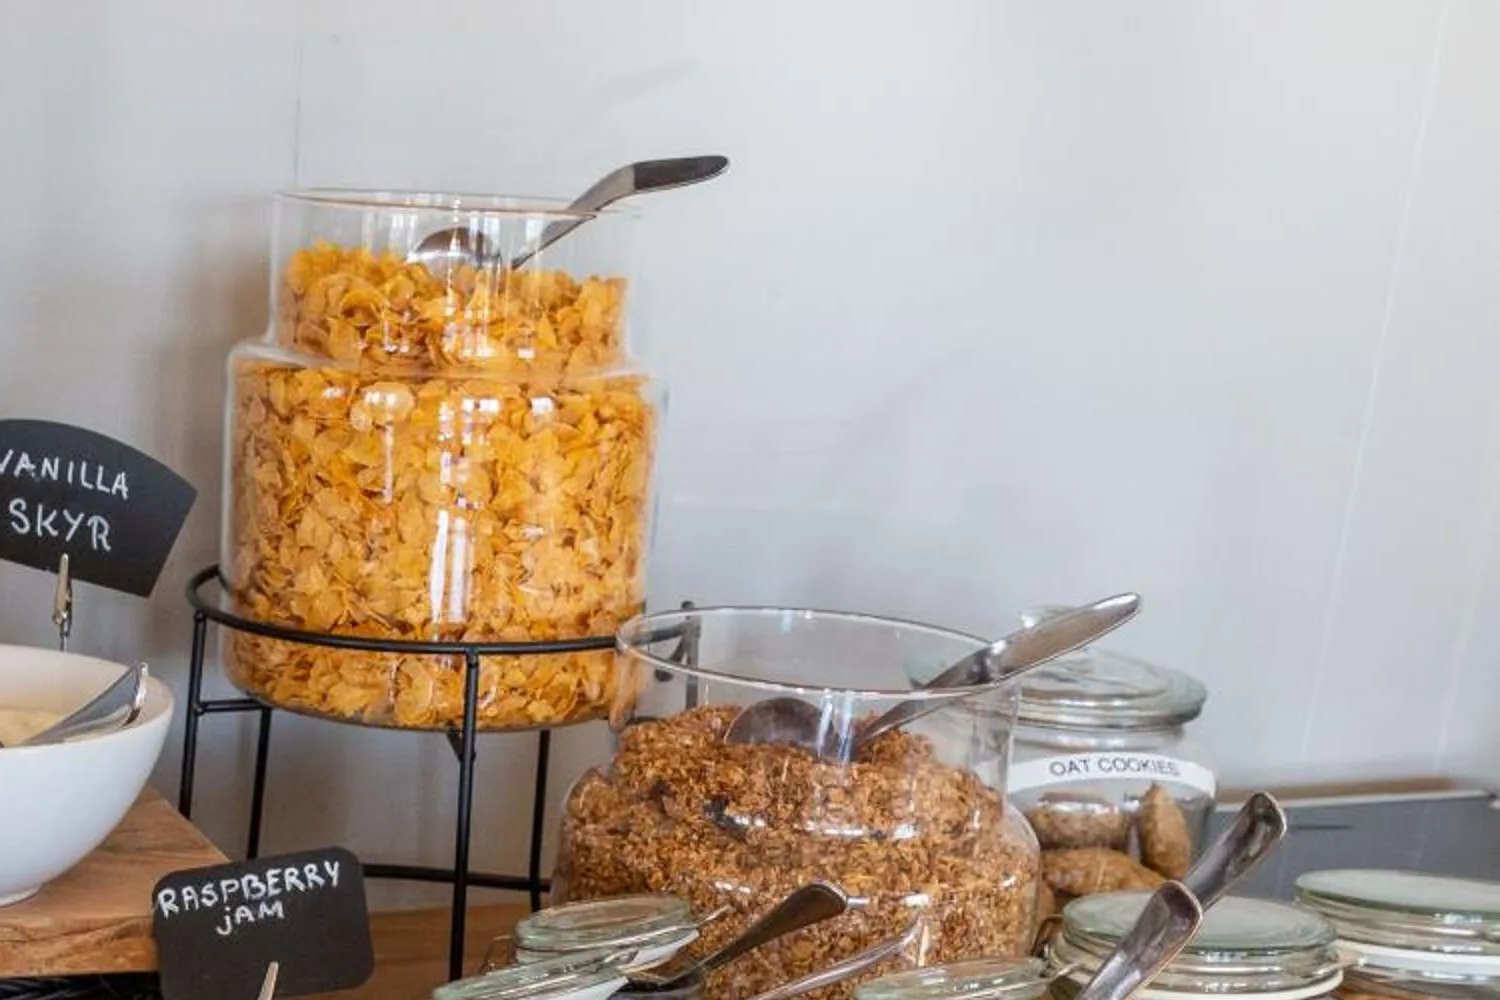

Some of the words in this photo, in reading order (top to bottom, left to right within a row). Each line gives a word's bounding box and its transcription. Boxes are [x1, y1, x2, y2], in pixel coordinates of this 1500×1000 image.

[9, 498, 111, 552] SKYR
[1050, 759, 1091, 777] OAT
[1098, 757, 1181, 777] COOKIES
[157, 860, 340, 918] RASPBERRY
